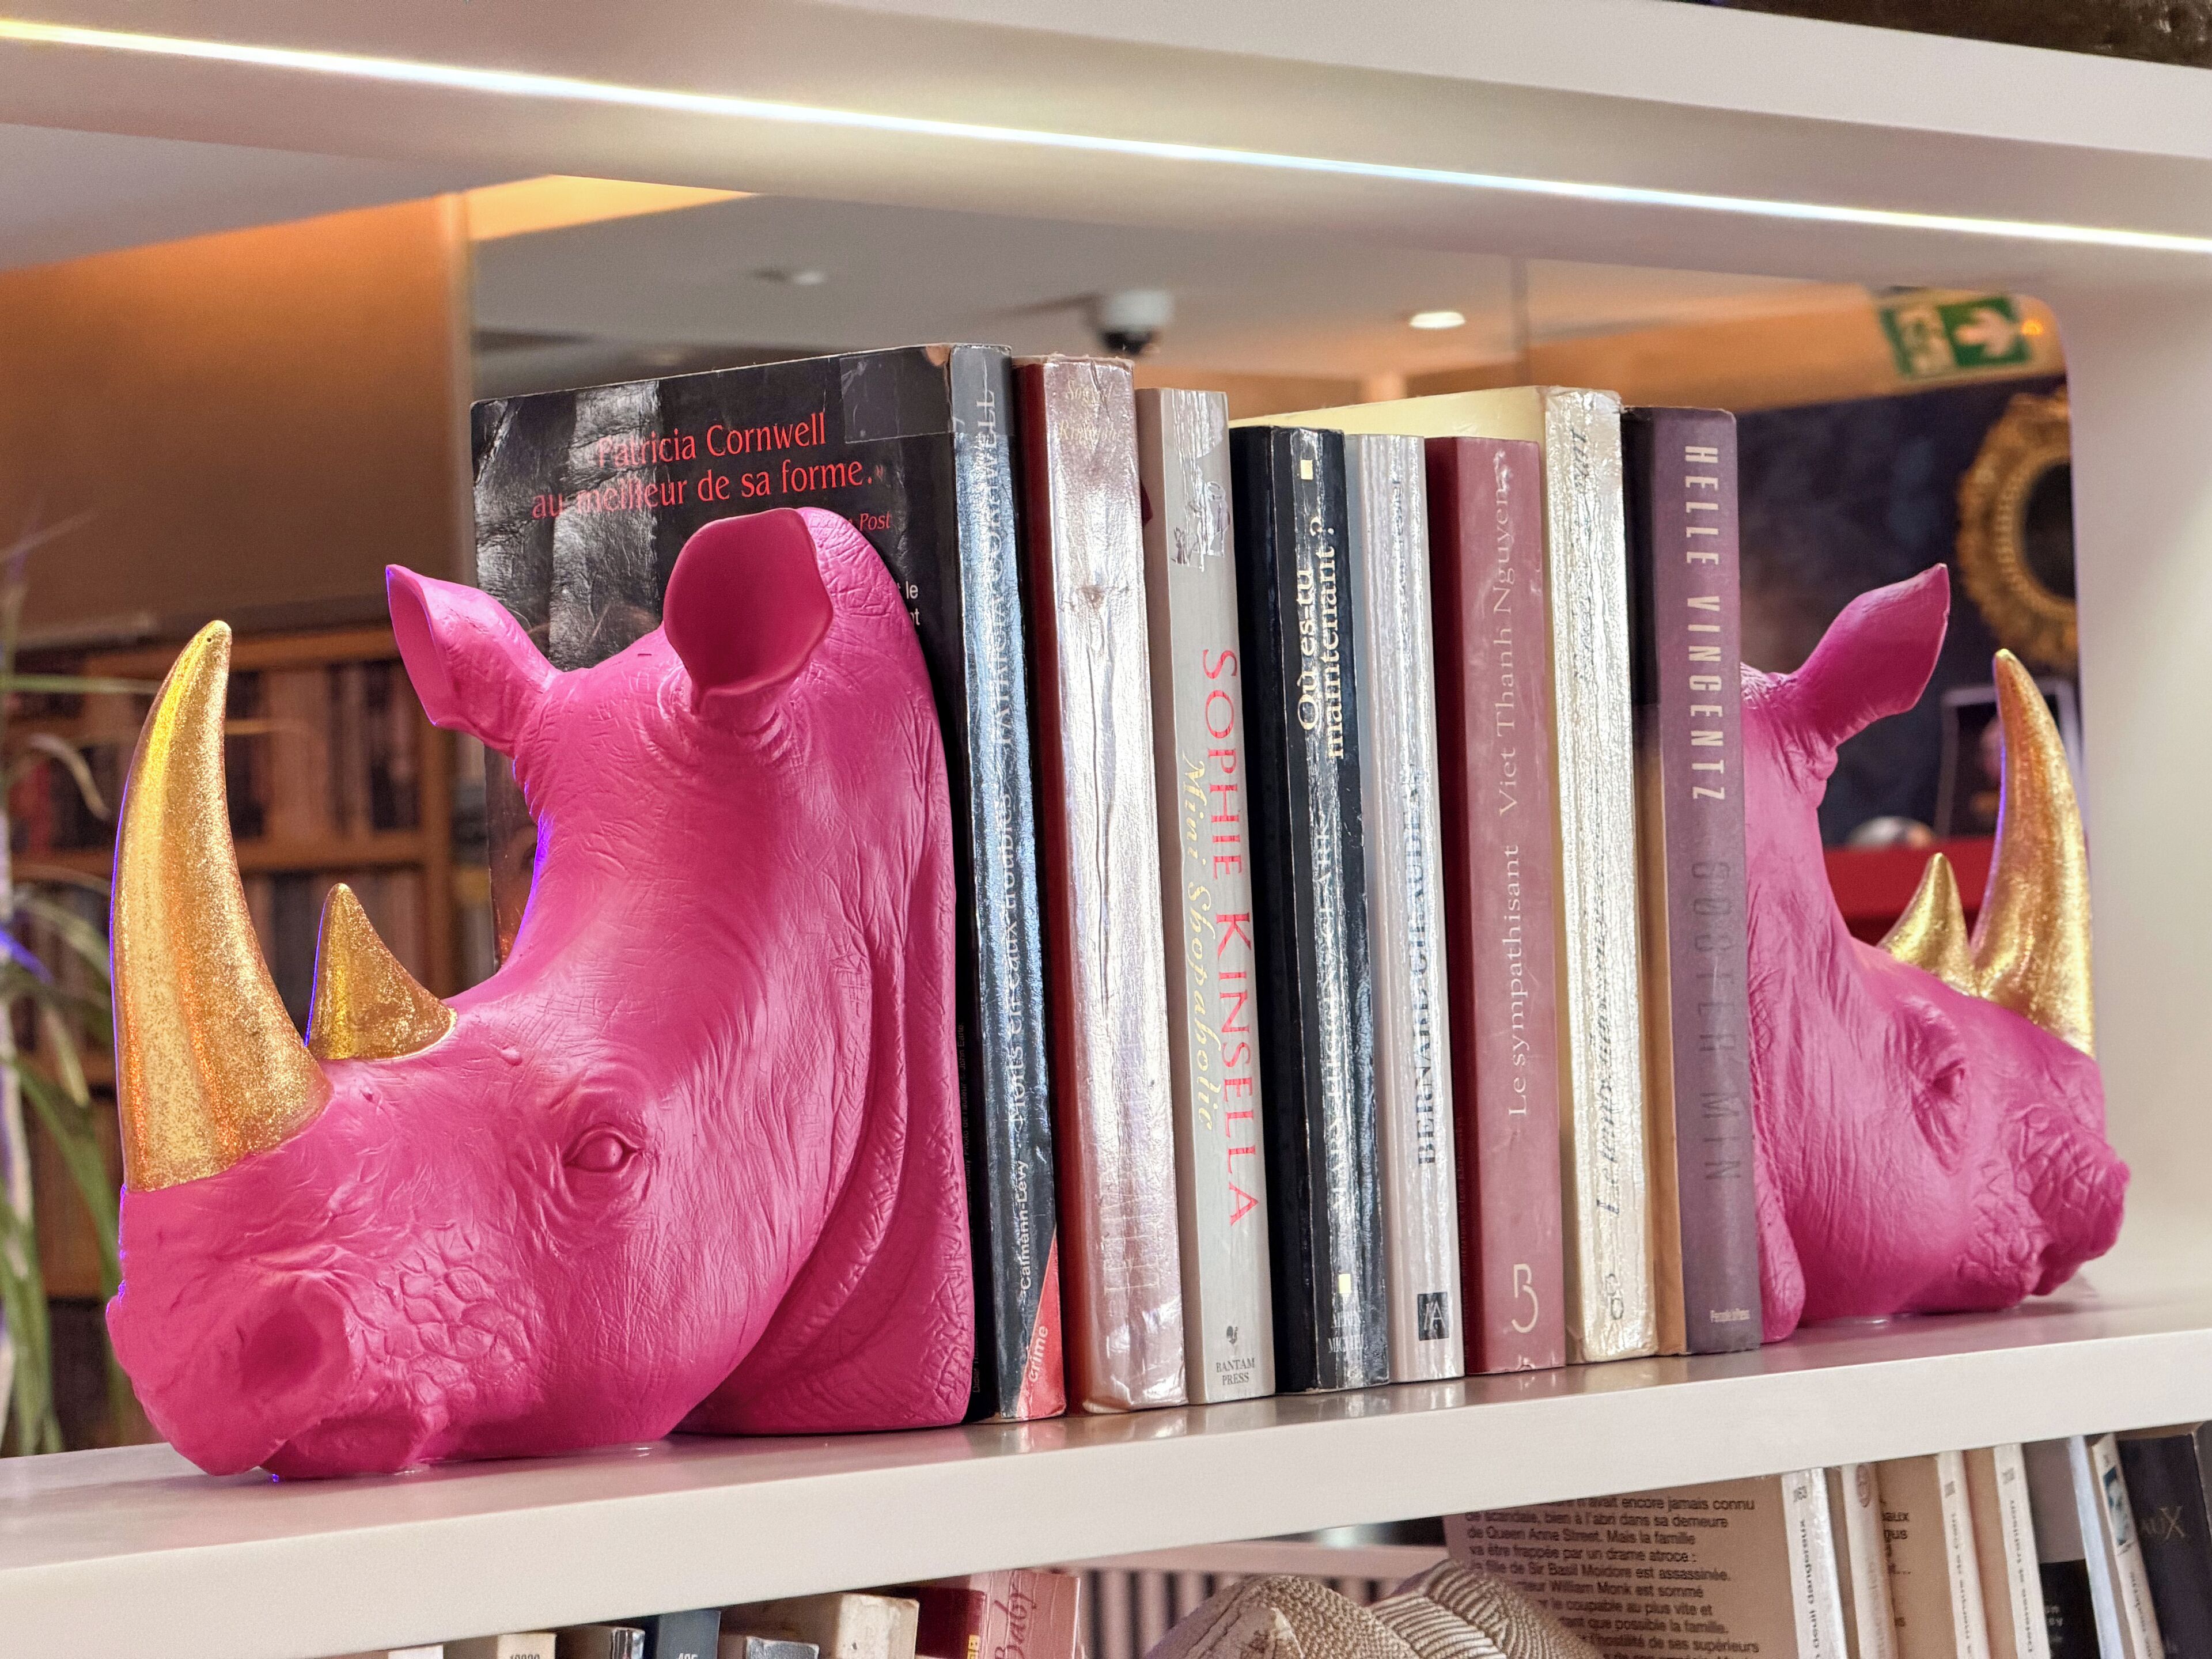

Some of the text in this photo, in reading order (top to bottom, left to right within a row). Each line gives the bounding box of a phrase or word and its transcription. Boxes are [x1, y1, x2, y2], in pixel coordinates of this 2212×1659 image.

[597, 411, 826, 468] Patricia Cornwell
[532, 493, 563, 518] au
[576, 480, 687, 514] meilleur
[698, 469, 730, 501] de
[741, 471, 771, 498] sa
[859, 511, 891, 531] Post
[976, 390, 1003, 582] CORNWELL
[906, 580, 919, 600] le
[1685, 446, 1725, 800] HELLE VINCENTZ
[1296, 567, 1320, 730] Où es-tu
[1317, 546, 1344, 760] maintenant
[1492, 488, 1529, 1116] Le sympathisant Viet Thanh Nguyen
[1003, 921, 1020, 993] eaux
[1183, 753, 1221, 1130] Mini Shopaholic
[1202, 649, 1259, 1226] SOPHIE KINSELLA
[1006, 1046, 1028, 1123] Morts
[1413, 989, 1435, 1165] BERNARD
[1700, 1093, 1741, 1180] MIN
[1216, 1358, 1255, 1385] BANTAM PRESS
[1654, 1531, 1696, 1544] famille
[1672, 1514, 1729, 1528] demeure
[1713, 1499, 1755, 1510] connu
[1799, 1519, 1815, 1605] dangereux
